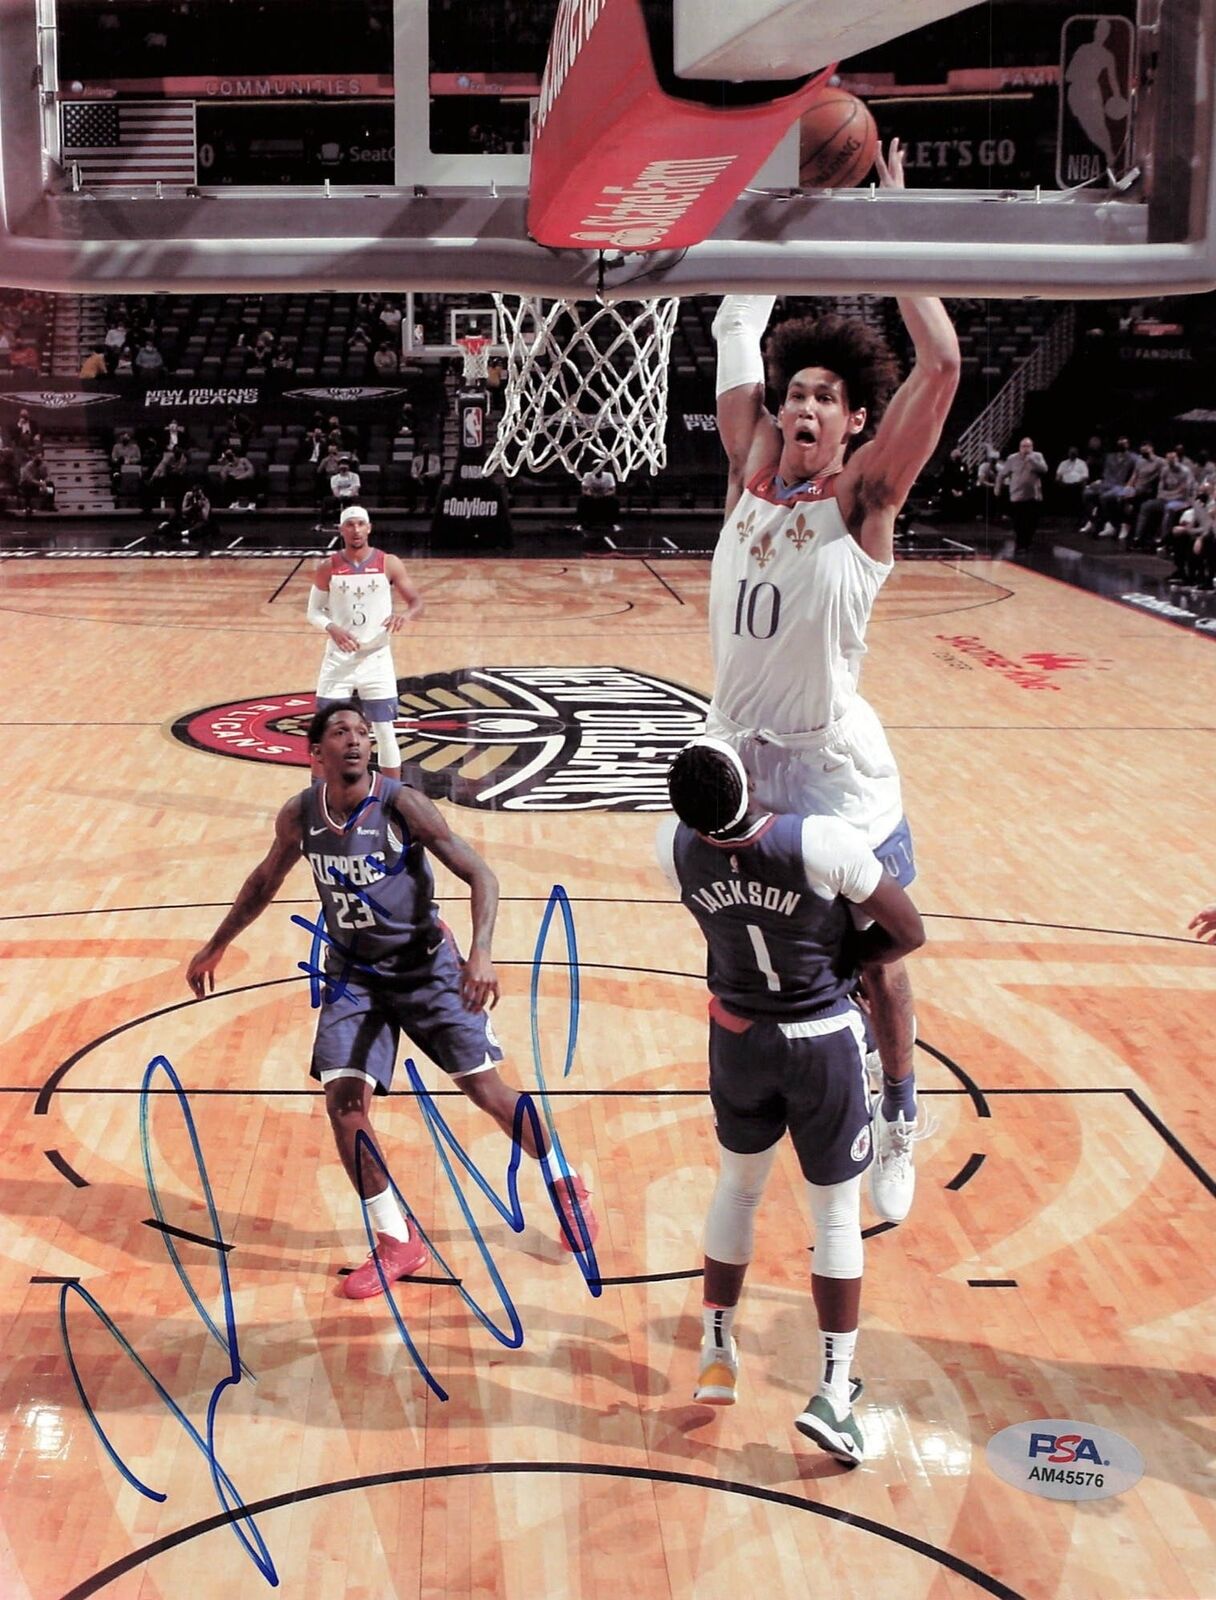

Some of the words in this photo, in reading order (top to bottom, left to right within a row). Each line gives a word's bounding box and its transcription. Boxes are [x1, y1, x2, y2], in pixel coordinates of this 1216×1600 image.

[206, 80, 362, 95] COMMUNITIES
[979, 139, 1015, 165] GO
[1067, 154, 1100, 181] NBA
[144, 395, 258, 407] PELICANS
[189, 388, 258, 397] ORLEANS
[443, 498, 498, 519] #OnlyHere
[351, 603, 367, 627] 5
[732, 578, 781, 640] 10
[210, 699, 311, 755] PELICANS
[308, 851, 386, 886] CLIPPERS
[331, 891, 376, 930] 23
[691, 880, 801, 916] JACKSON
[746, 924, 781, 992] 1
